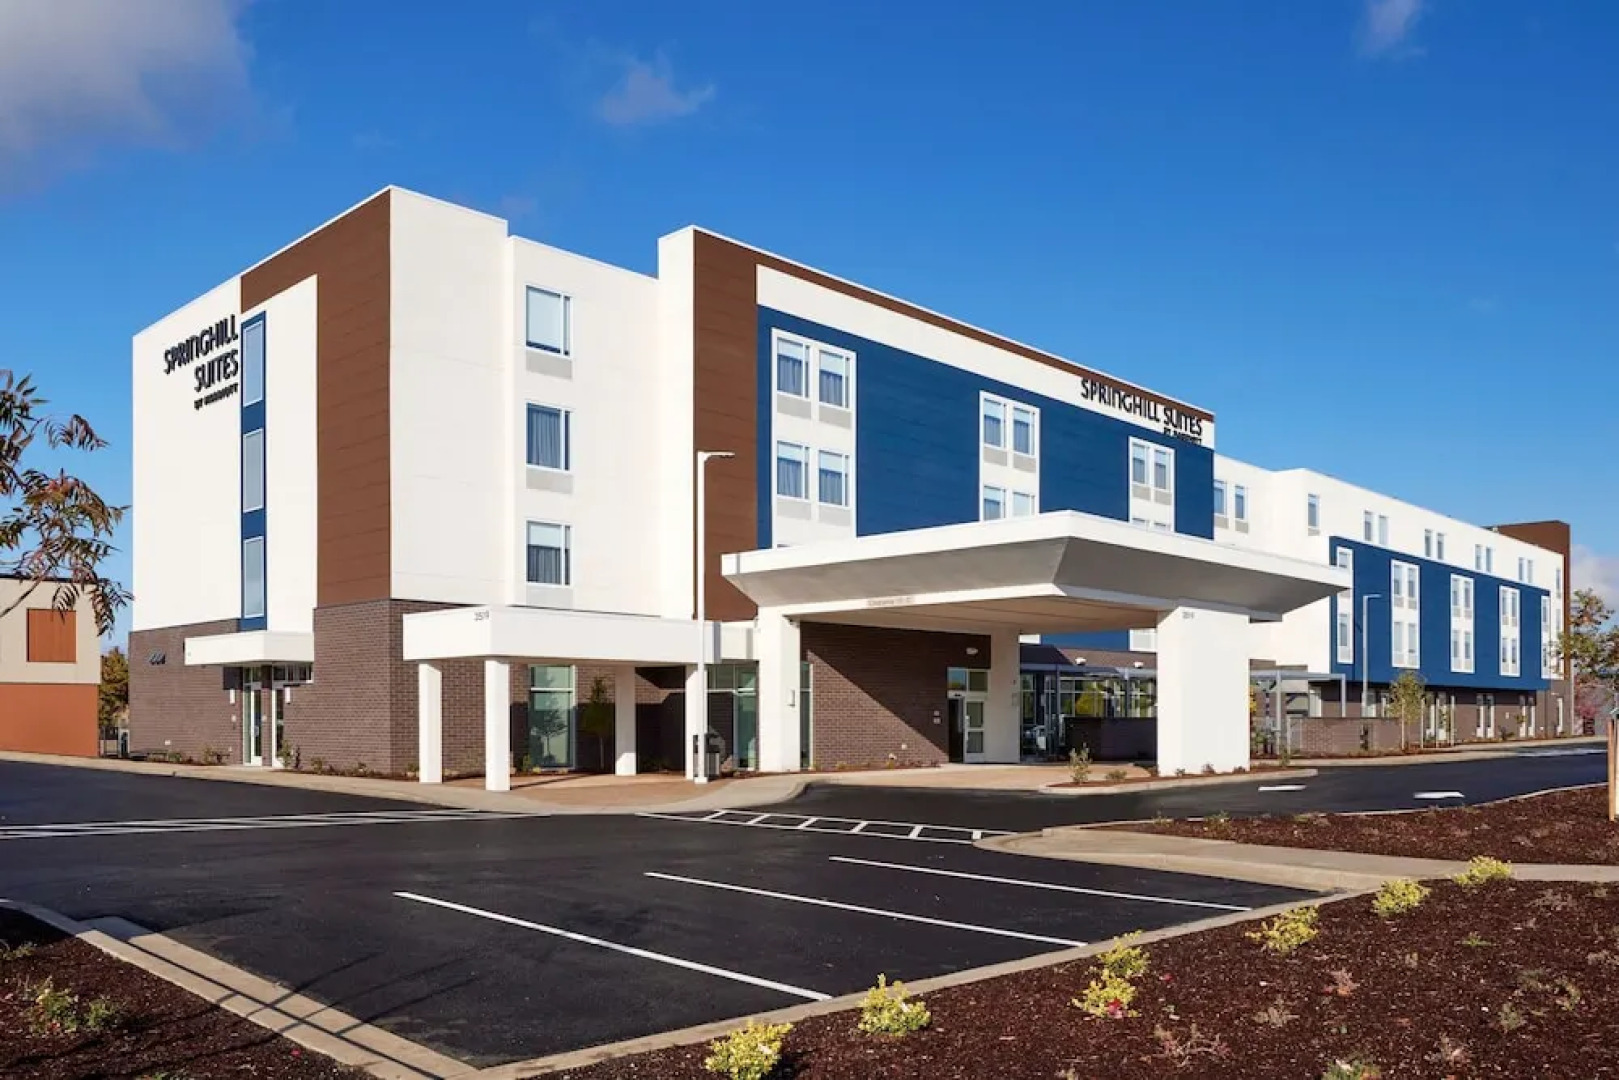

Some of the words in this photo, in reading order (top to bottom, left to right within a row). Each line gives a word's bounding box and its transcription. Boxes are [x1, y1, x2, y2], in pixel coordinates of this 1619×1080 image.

[164, 314, 238, 374] SPRINGHILL
[194, 349, 238, 392] SUITES
[1081, 379, 1160, 422] SPRINGHILL
[1163, 406, 1203, 436] SUITES
